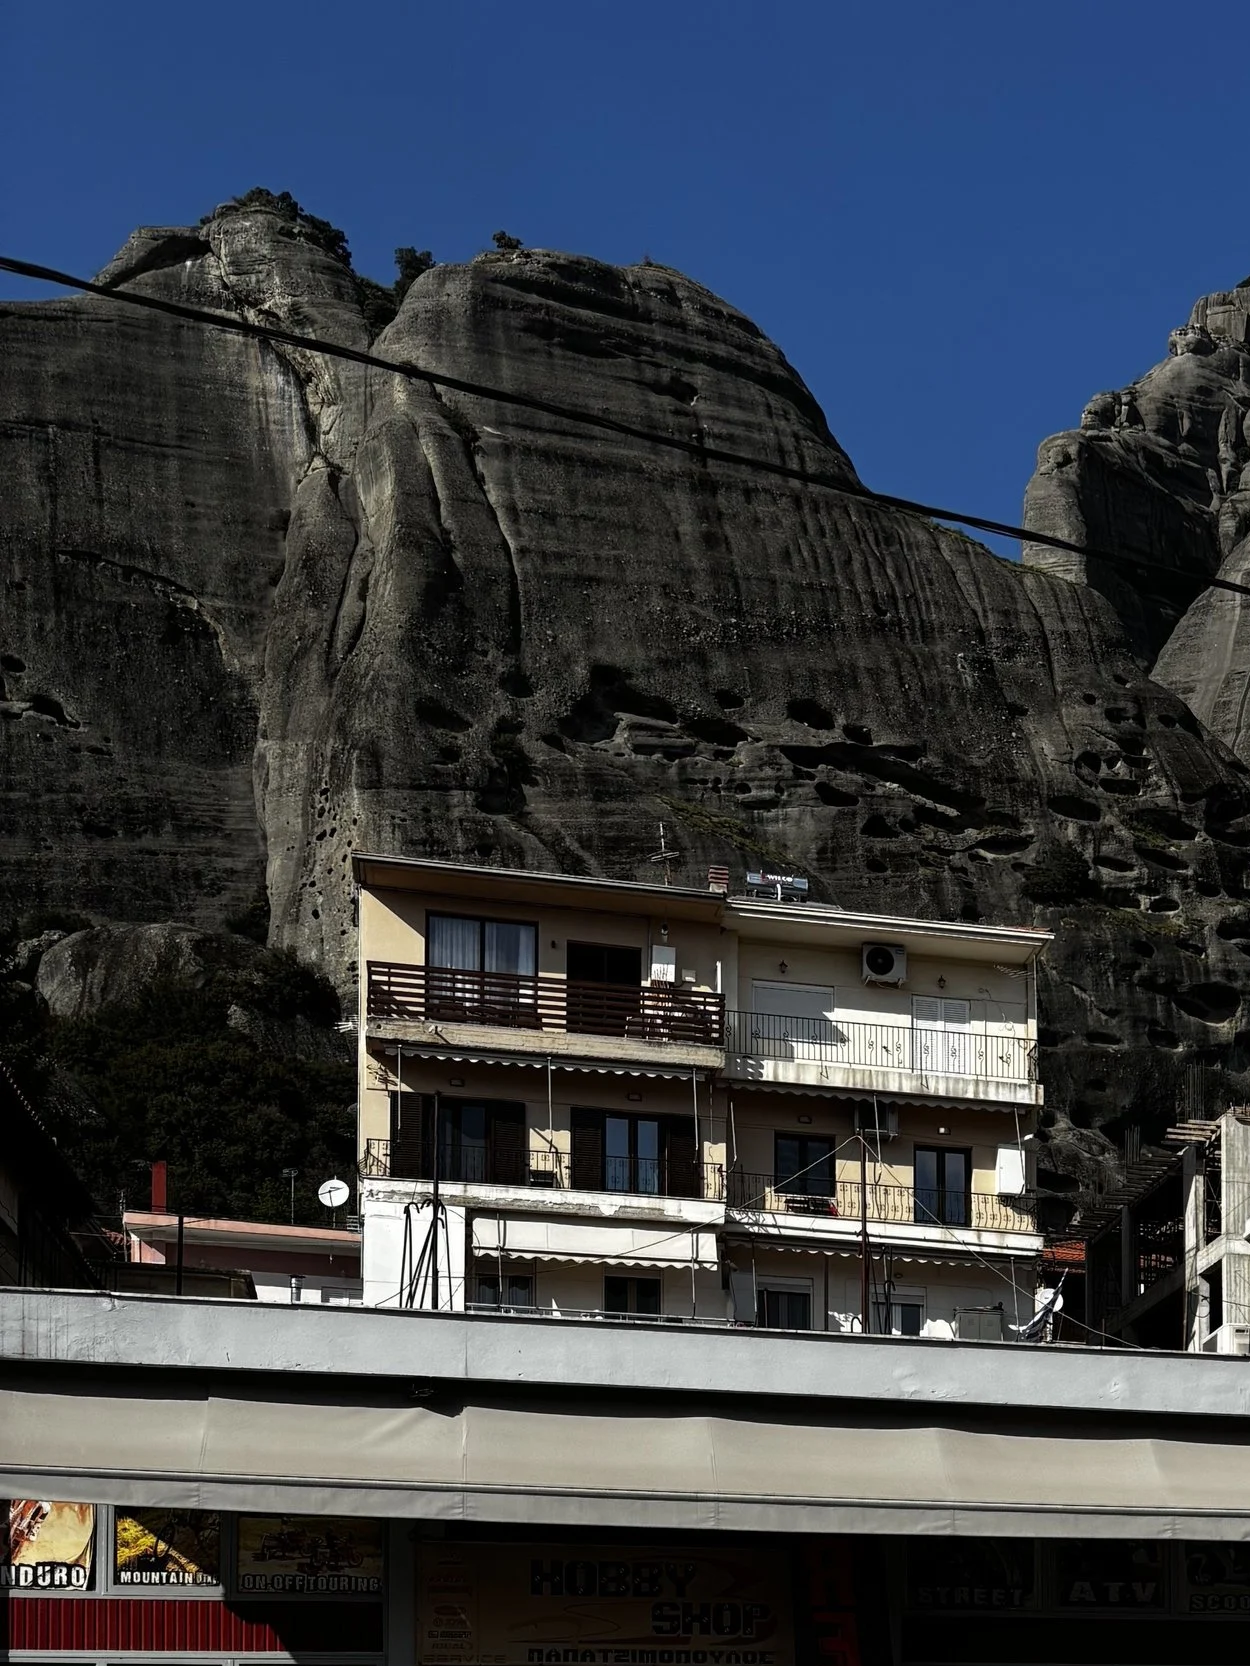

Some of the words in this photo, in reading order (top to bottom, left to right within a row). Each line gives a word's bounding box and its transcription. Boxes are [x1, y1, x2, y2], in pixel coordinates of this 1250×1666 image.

[0, 1565, 86, 1587] NDURO
[120, 1571, 194, 1585] MOUNTAIN
[308, 1576, 381, 1592] TOURING
[529, 1558, 700, 1598] HOBBY
[916, 1587, 1023, 1605] STREET
[1068, 1580, 1157, 1603] ATV
[651, 1602, 772, 1636] SHOP
[423, 1654, 506, 1664] SERVICE
